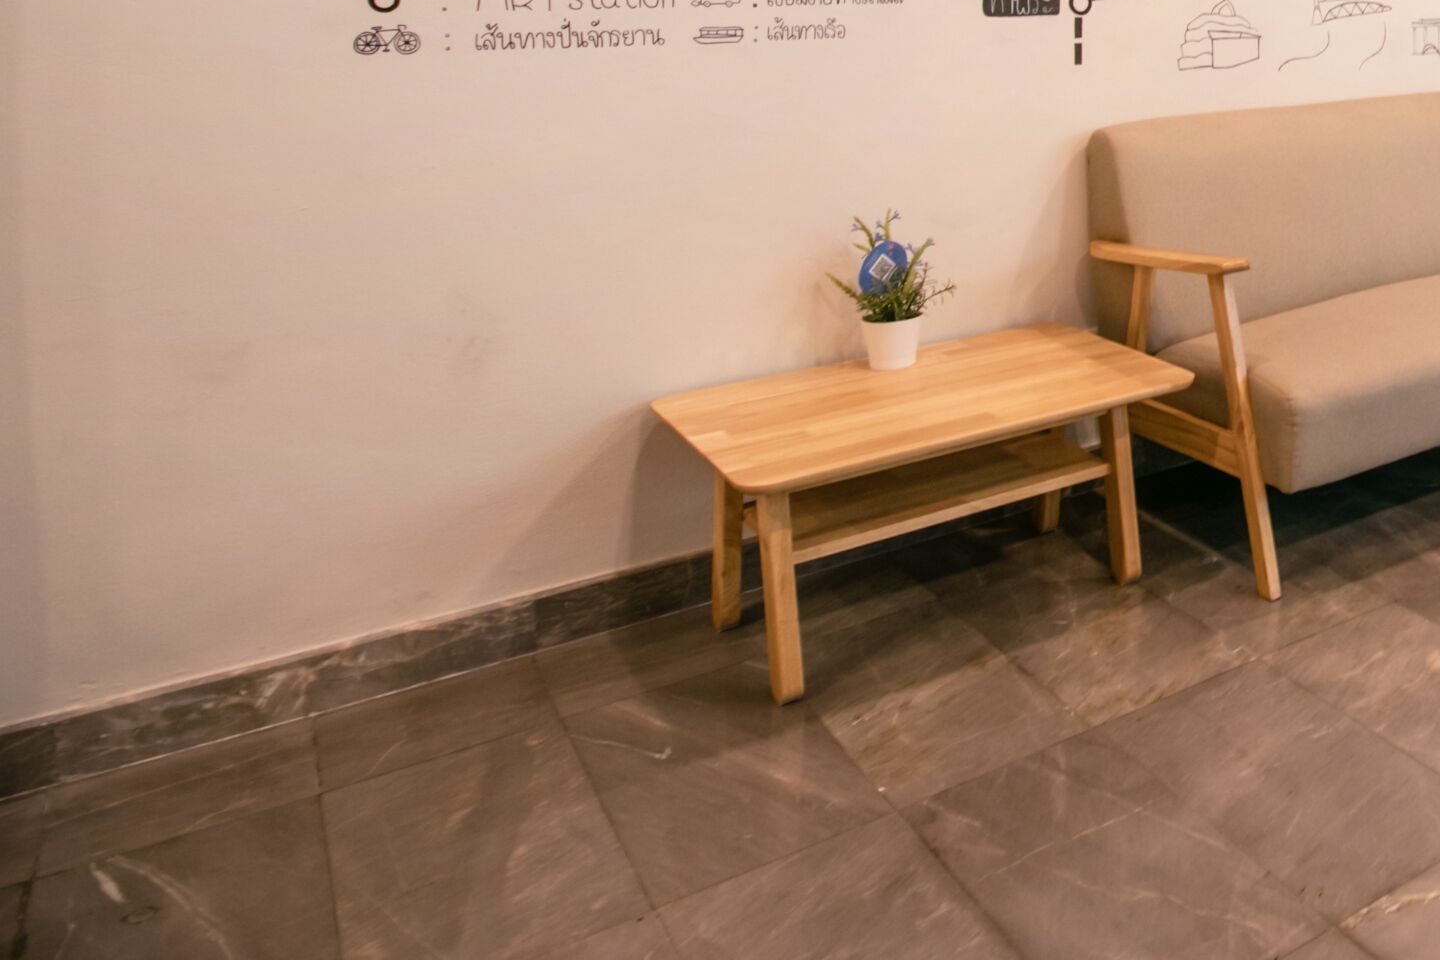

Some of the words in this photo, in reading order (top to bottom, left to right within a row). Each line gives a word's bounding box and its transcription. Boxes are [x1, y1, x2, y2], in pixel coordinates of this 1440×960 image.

[474, 17, 666, 51] เส้นทางปั่นจักรยาน
[765, 16, 847, 42] เส้นทางเรือ
